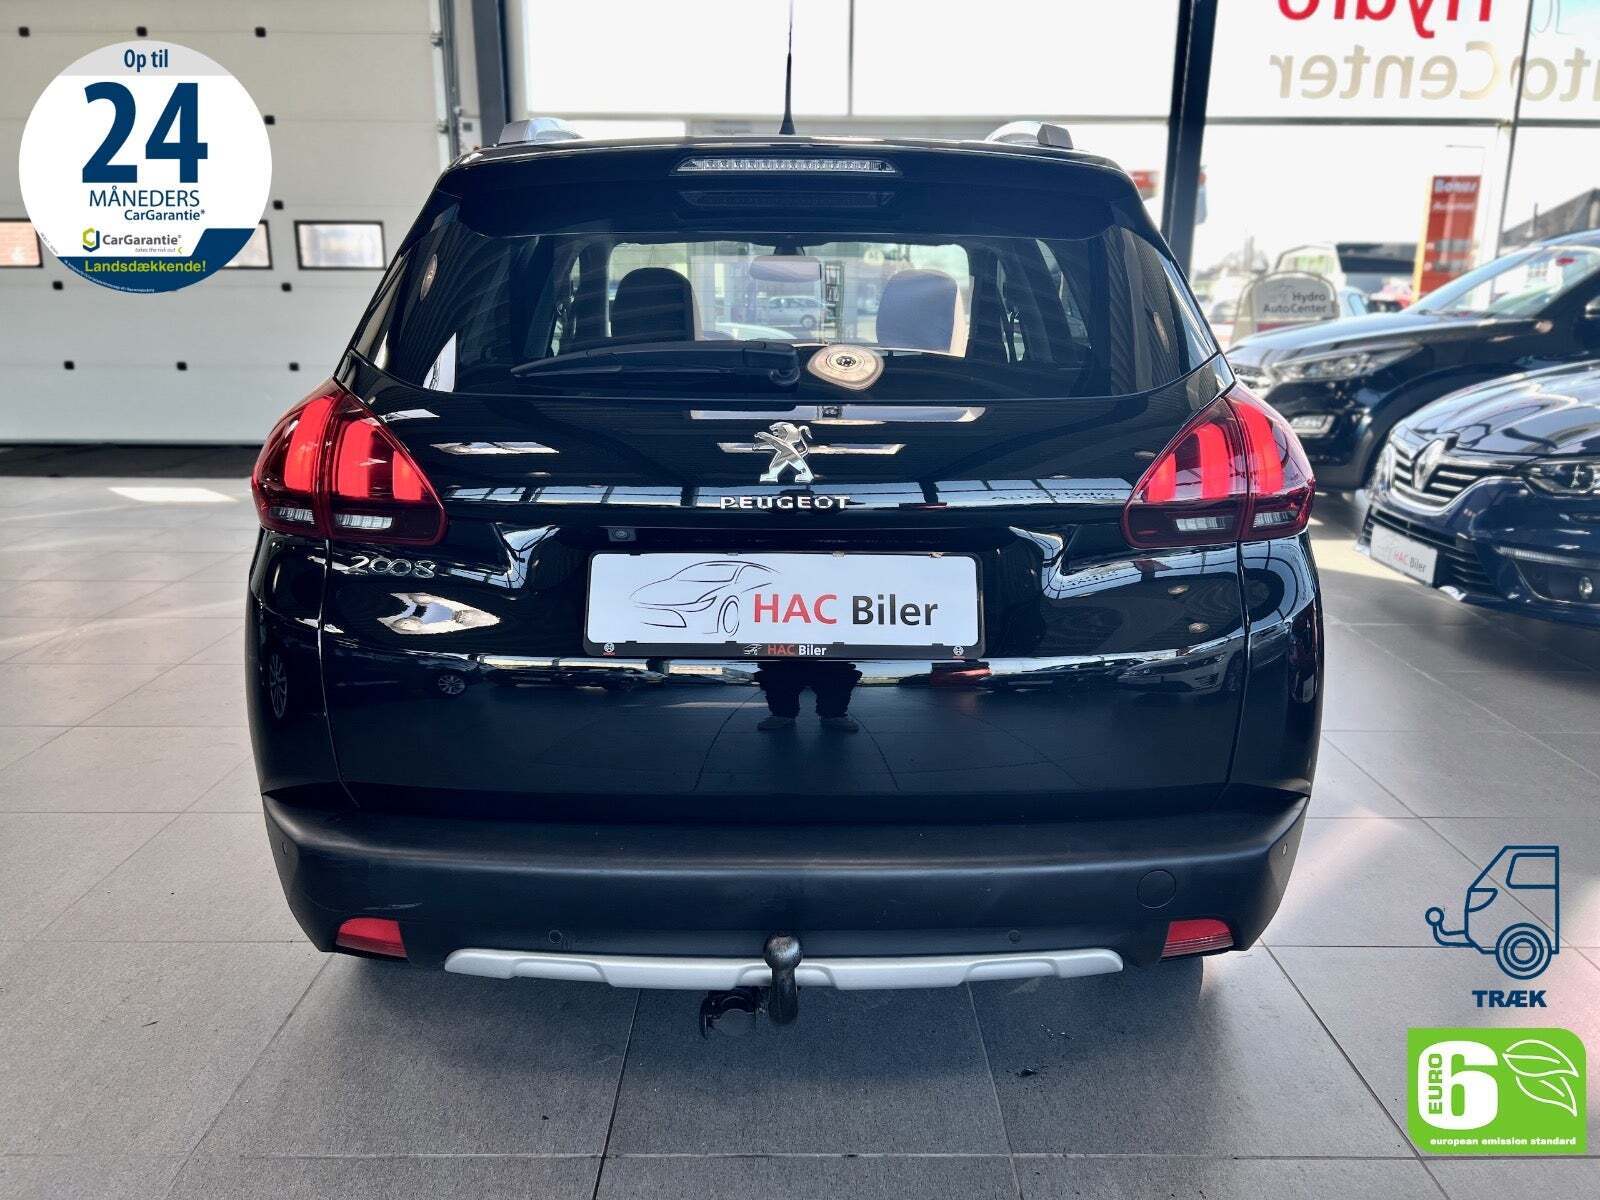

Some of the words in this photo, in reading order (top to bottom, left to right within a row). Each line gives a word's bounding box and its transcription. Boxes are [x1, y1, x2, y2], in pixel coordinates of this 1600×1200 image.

[1292, 292, 1327, 302] Hydro
[720, 496, 850, 510] PEUGEOT
[347, 554, 436, 579] 2008
[1394, 551, 1408, 566] HAC
[1410, 557, 1427, 573] Biler
[754, 593, 838, 625] HAC
[852, 594, 938, 626] Biler
[768, 644, 795, 656] HAC
[798, 644, 827, 656] Biler
